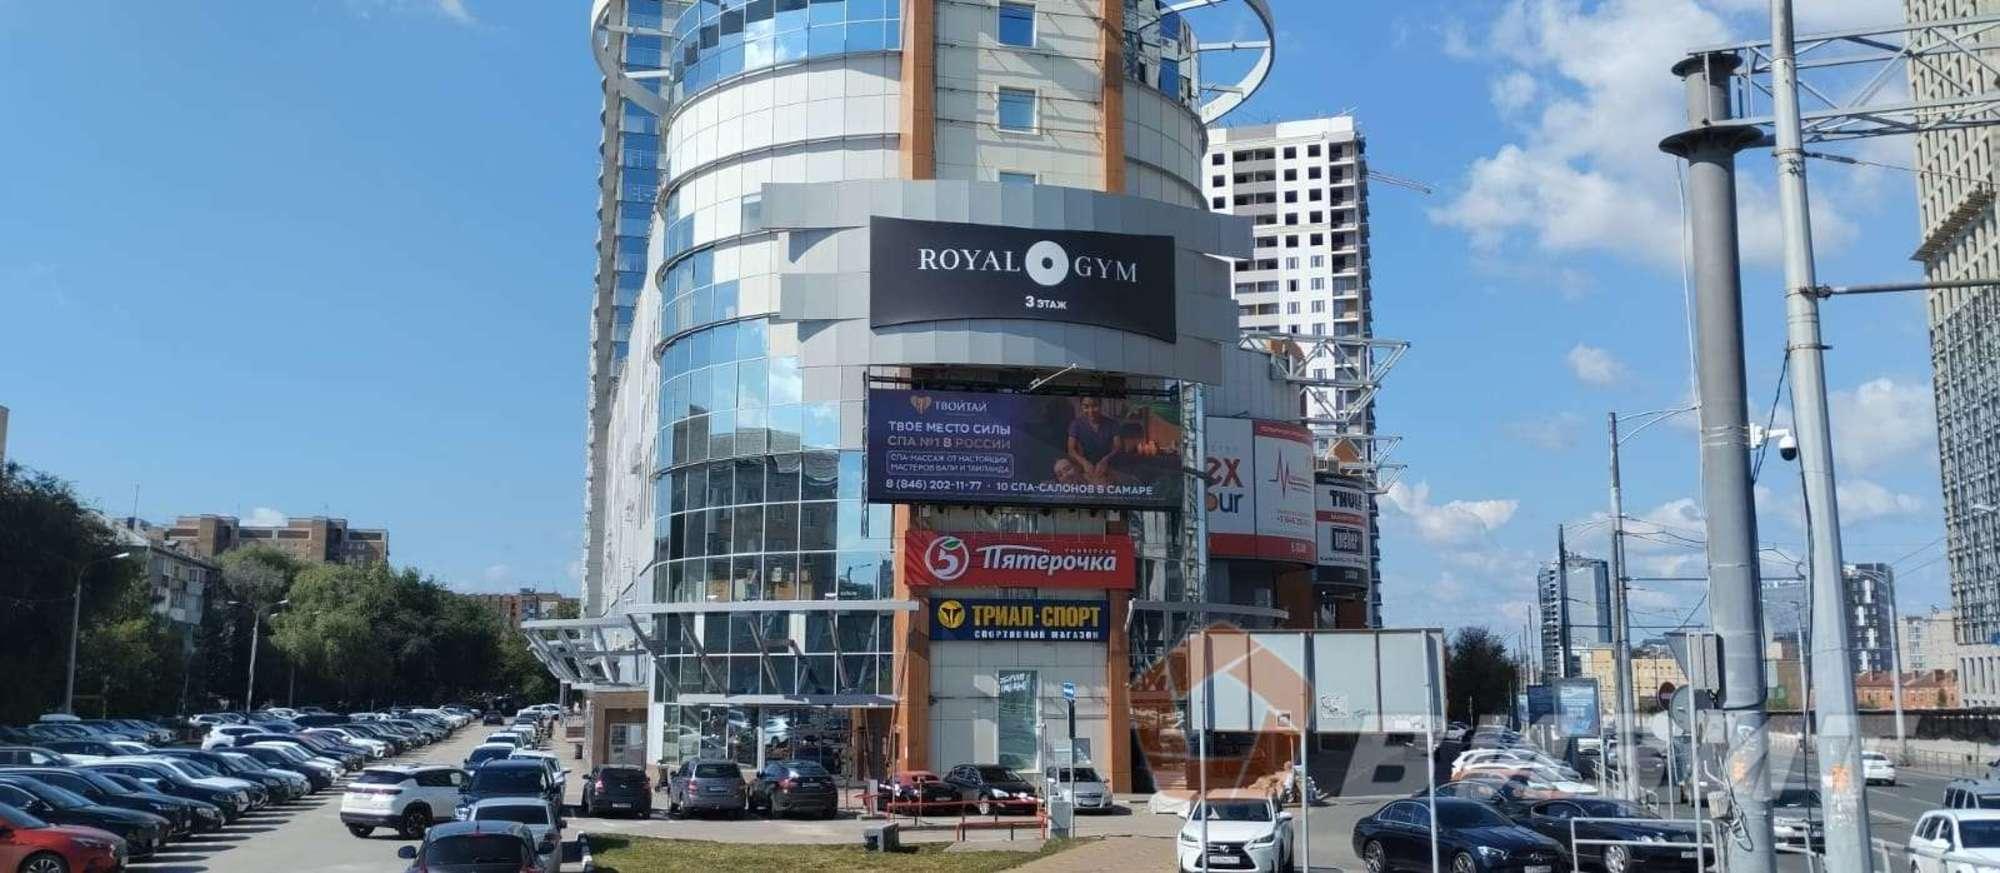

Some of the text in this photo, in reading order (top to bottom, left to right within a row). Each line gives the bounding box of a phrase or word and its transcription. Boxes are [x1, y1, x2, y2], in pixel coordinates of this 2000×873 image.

[918, 249, 1137, 283] ROYAL GYM
[1025, 296, 1066, 309] 3 ЭТАЖ
[888, 421, 1011, 435] ТВОЕ МЕСТО СИЛЫ
[887, 435, 916, 446] СПА
[955, 438, 1011, 449] РОССИИ
[886, 479, 893, 489] 8
[896, 479, 927, 490] (846)
[929, 480, 982, 491] 202-11-77
[996, 482, 1008, 491] 10
[1010, 482, 1094, 494] СПА-САЛОНОВ
[1107, 485, 1153, 495] САМАРЕ
[974, 630, 1099, 639] СПОРТИВНЫЙ МАГАЗИН
